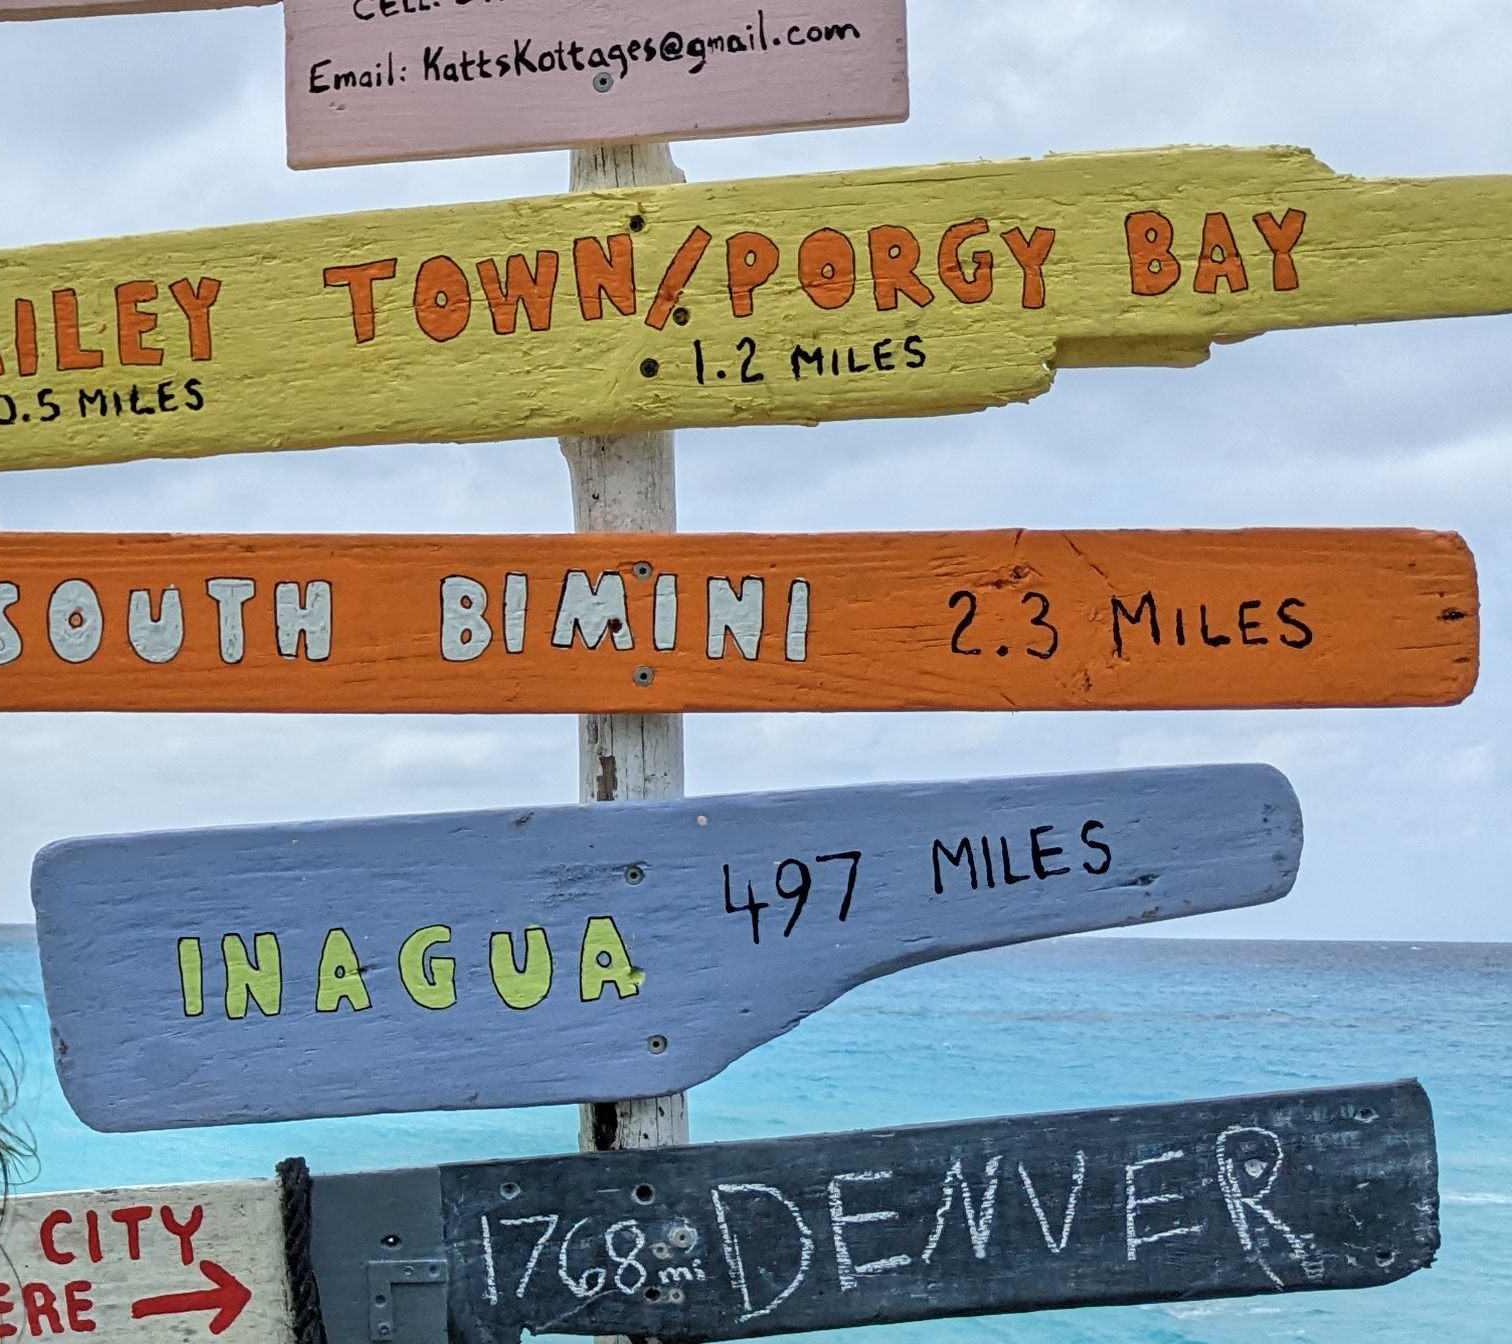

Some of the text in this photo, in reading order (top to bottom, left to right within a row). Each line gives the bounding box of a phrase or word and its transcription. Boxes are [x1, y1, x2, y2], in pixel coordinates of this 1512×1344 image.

[308, 52, 407, 94] Email:
[1124, 208, 1308, 295] BAY
[693, 336, 927, 385] 1.2 MILES
[79, 379, 206, 418] MILES
[439, 569, 810, 663] BIMINI
[948, 590, 1059, 658] 2.3
[1110, 591, 1314, 658] MILES
[176, 819, 1114, 1020] INAGUA 497 MILES
[39, 1204, 204, 1266] CITY
[711, 1124, 1310, 1323] DENVER
